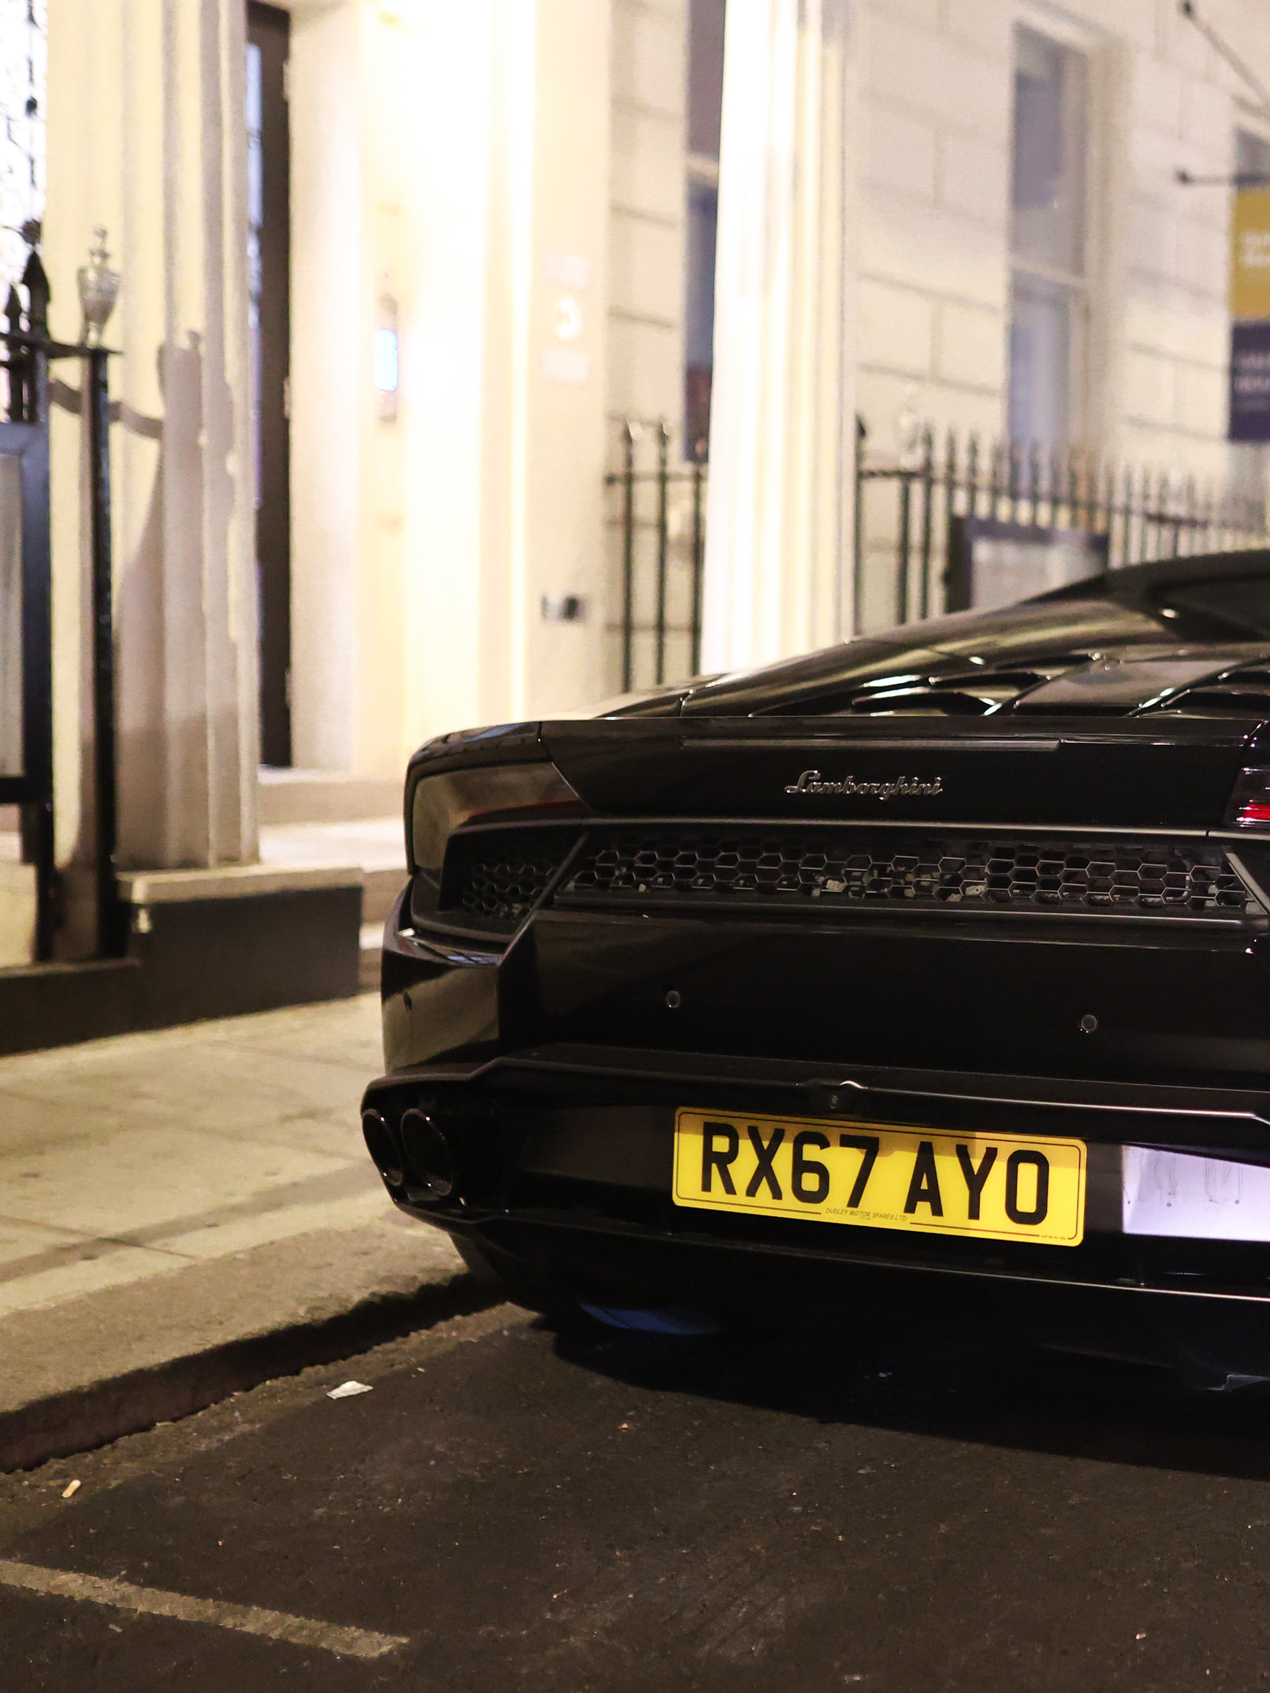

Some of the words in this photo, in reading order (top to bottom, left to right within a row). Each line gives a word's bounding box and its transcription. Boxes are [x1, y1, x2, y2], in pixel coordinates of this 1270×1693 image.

[784, 769, 943, 800] Lamborghini
[701, 1121, 880, 1209] RX67
[903, 1140, 1050, 1226] AYO
[825, 1207, 848, 1215] DUDLEY
[849, 1209, 870, 1217] MOTOR
[872, 1212, 894, 1220] SPARES
